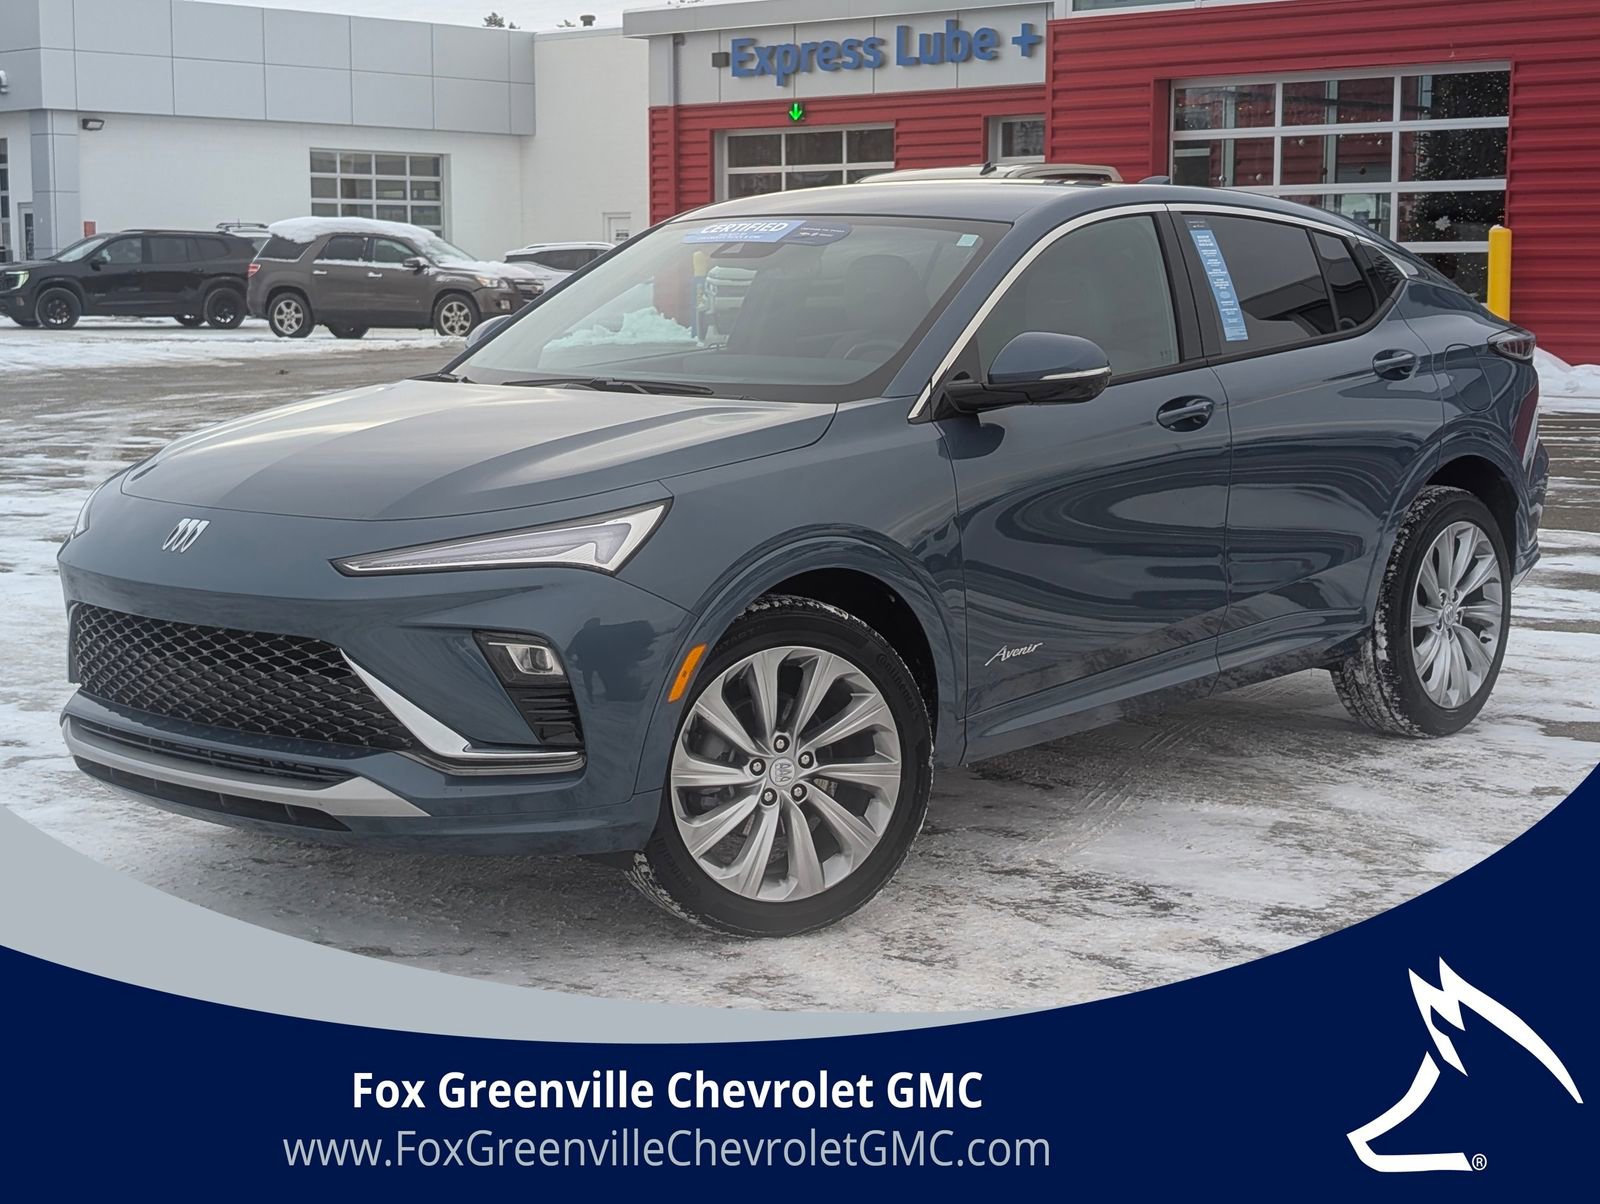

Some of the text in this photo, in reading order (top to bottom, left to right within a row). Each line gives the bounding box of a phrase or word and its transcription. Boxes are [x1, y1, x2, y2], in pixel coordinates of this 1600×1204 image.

[731, 35, 885, 87] Express
[896, 18, 999, 67] Lube
[700, 221, 789, 235] CERTIFIED
[984, 642, 1043, 667] Avenir
